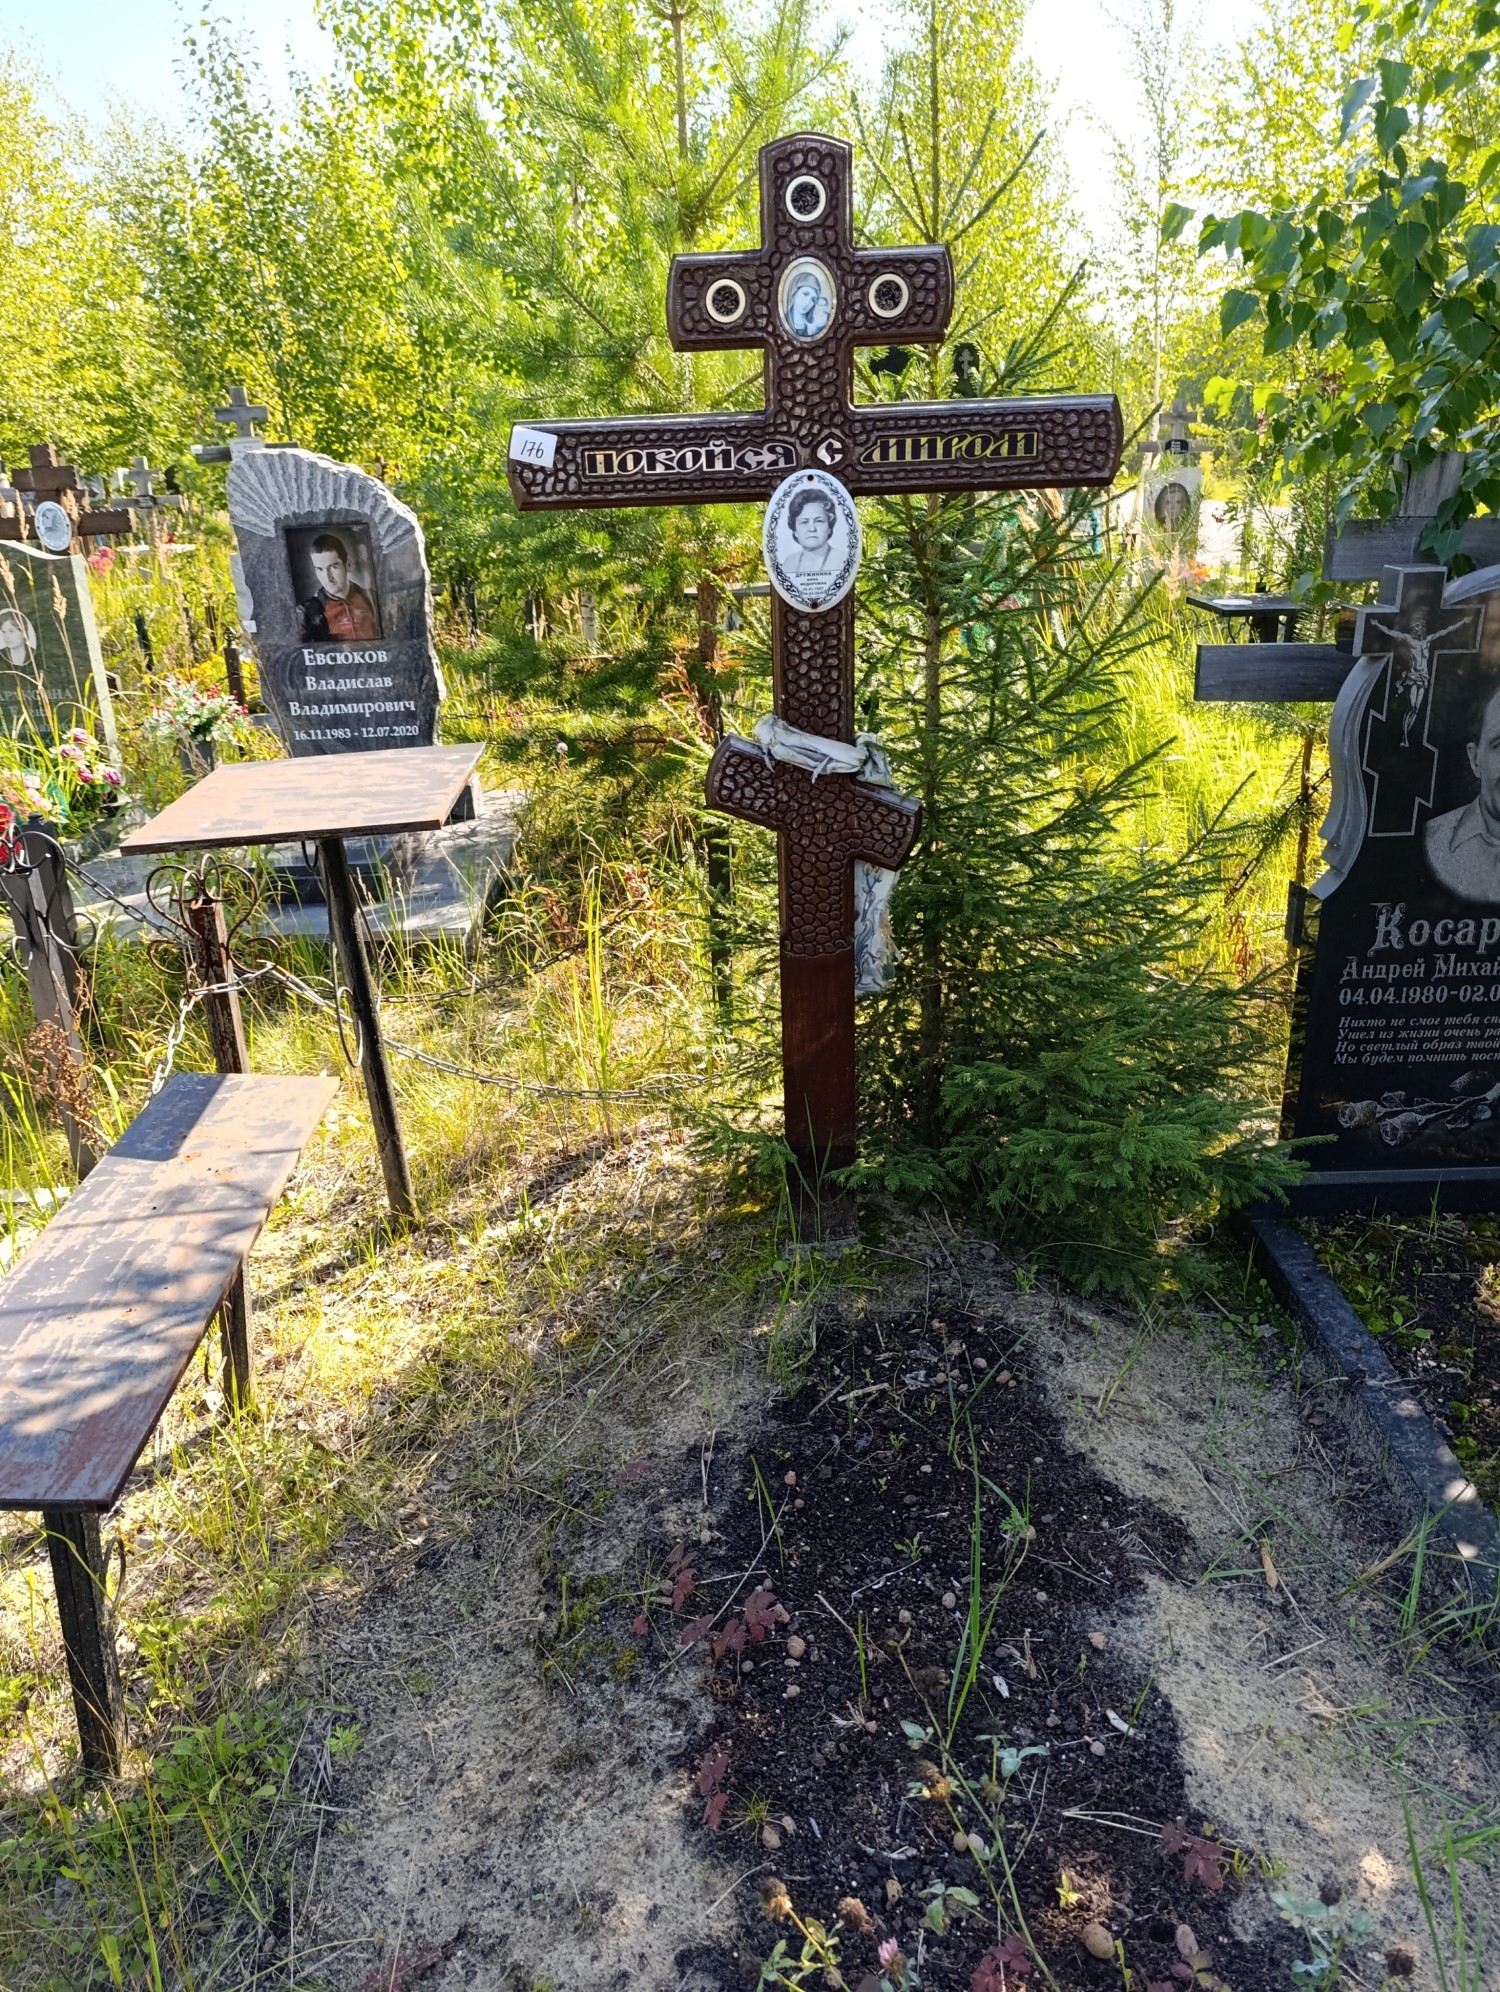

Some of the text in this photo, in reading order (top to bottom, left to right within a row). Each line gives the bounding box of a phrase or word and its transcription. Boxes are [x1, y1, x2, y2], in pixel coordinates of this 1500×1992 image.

[520, 439, 545, 459] 176
[305, 676, 393, 692] Владислав
[288, 701, 416, 717] Владимирович
[293, 728, 351, 741] 16.11.1983
[360, 725, 419, 738] 12.07.2020
[1367, 902, 1500, 957] Косар
[1339, 956, 1426, 984] Андрей
[1338, 1016, 1386, 1028] Никто
[1390, 1018, 1406, 1027] не
[1409, 1017, 1440, 1026] смог
[1444, 1012, 1480, 1025] тебя
[1337, 1028, 1374, 1040] Ушел
[1379, 1030, 1394, 1039] из
[1398, 1029, 1439, 1039] жизни
[1444, 1027, 1481, 1037] очень
[1335, 1041, 1355, 1053] Но
[1359, 1039, 1419, 1051] светлый
[1422, 1038, 1462, 1051] образ
[1333, 1053, 1357, 1065] Мы
[1361, 1051, 1403, 1066] будем
[1407, 1052, 1467, 1063] помнить
